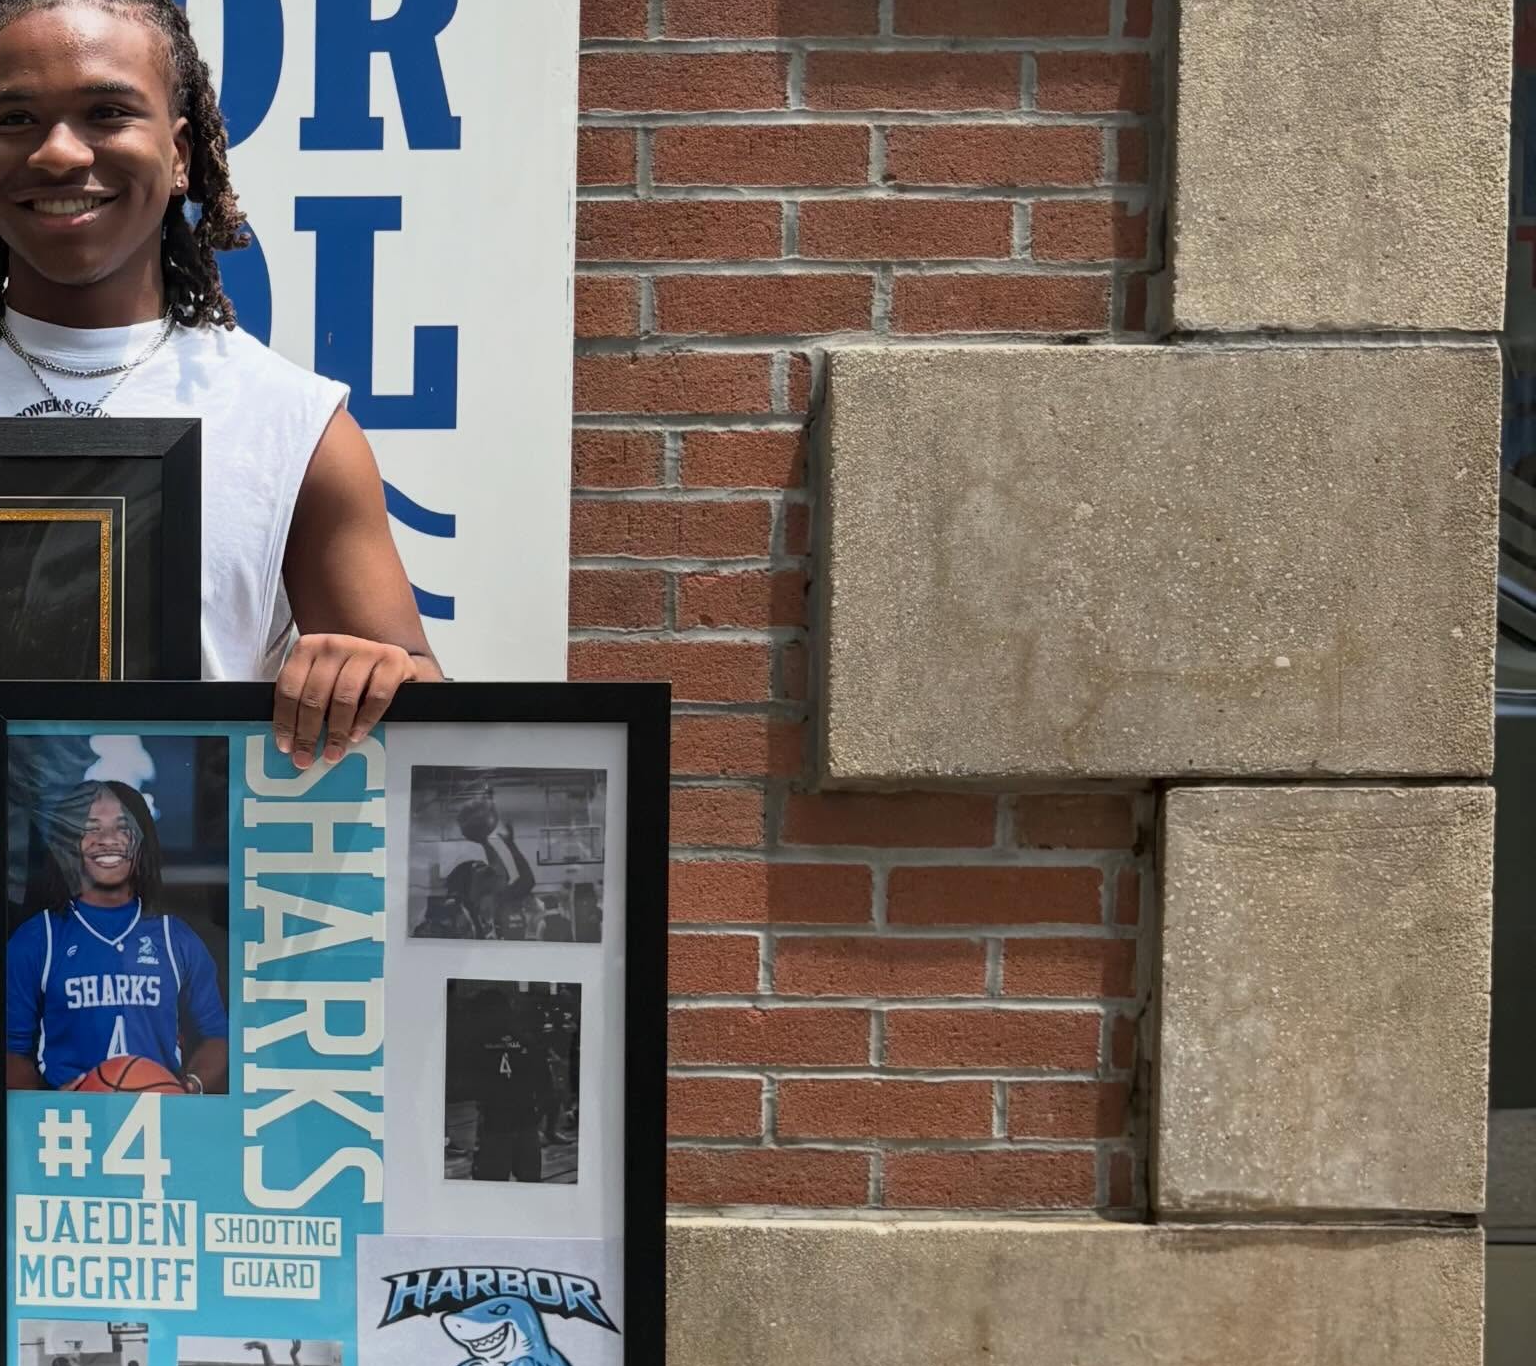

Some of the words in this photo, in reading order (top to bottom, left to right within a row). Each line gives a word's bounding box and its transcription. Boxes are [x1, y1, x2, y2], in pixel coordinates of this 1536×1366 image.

[65, 974, 161, 1009] SHARKS
[244, 734, 385, 1209] SHARKS
[38, 1091, 171, 1198] #4
[23, 1200, 187, 1246] JAEDEN
[213, 1217, 337, 1247] SHOOTING
[19, 1255, 193, 1302] MCGRIFF
[231, 1262, 315, 1289] GUARD
[382, 1267, 616, 1331] HARBOR
